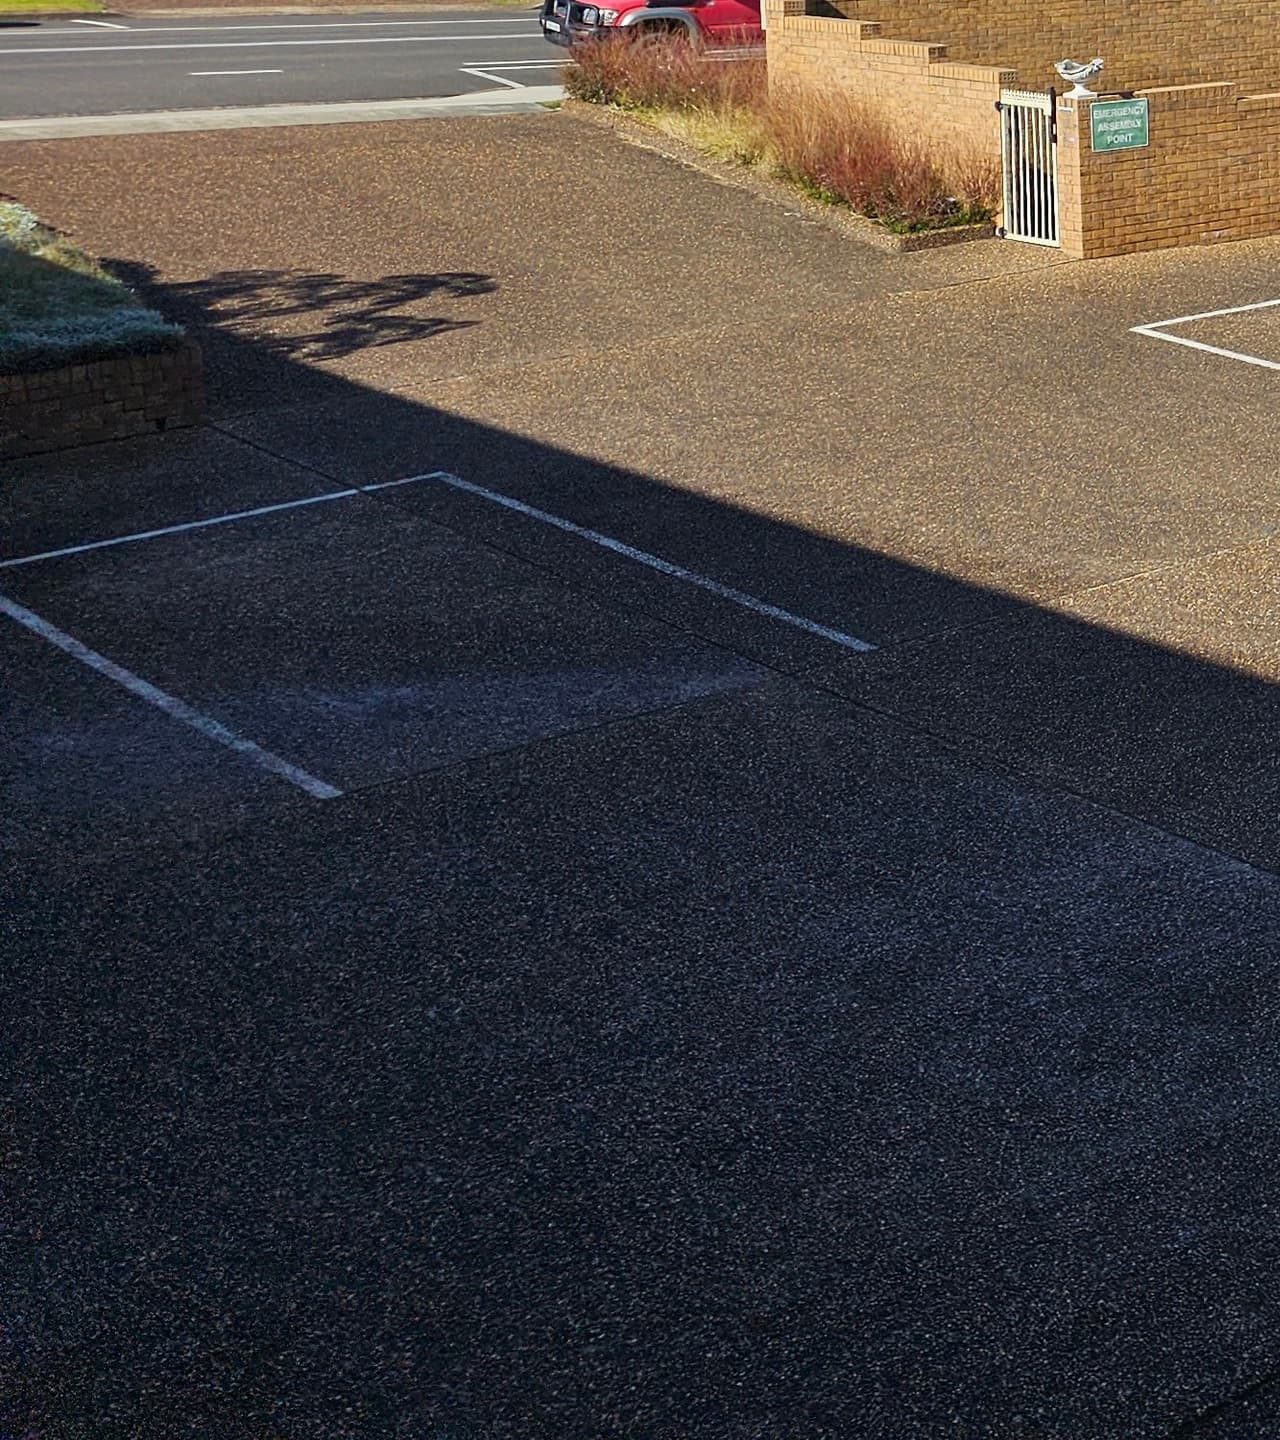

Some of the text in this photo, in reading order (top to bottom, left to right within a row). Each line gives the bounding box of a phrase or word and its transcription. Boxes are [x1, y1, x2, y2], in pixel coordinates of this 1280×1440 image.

[1093, 105, 1144, 119] EMERGENCY
[1097, 119, 1142, 132] ASSEMBLY
[1107, 133, 1134, 145] POINT
